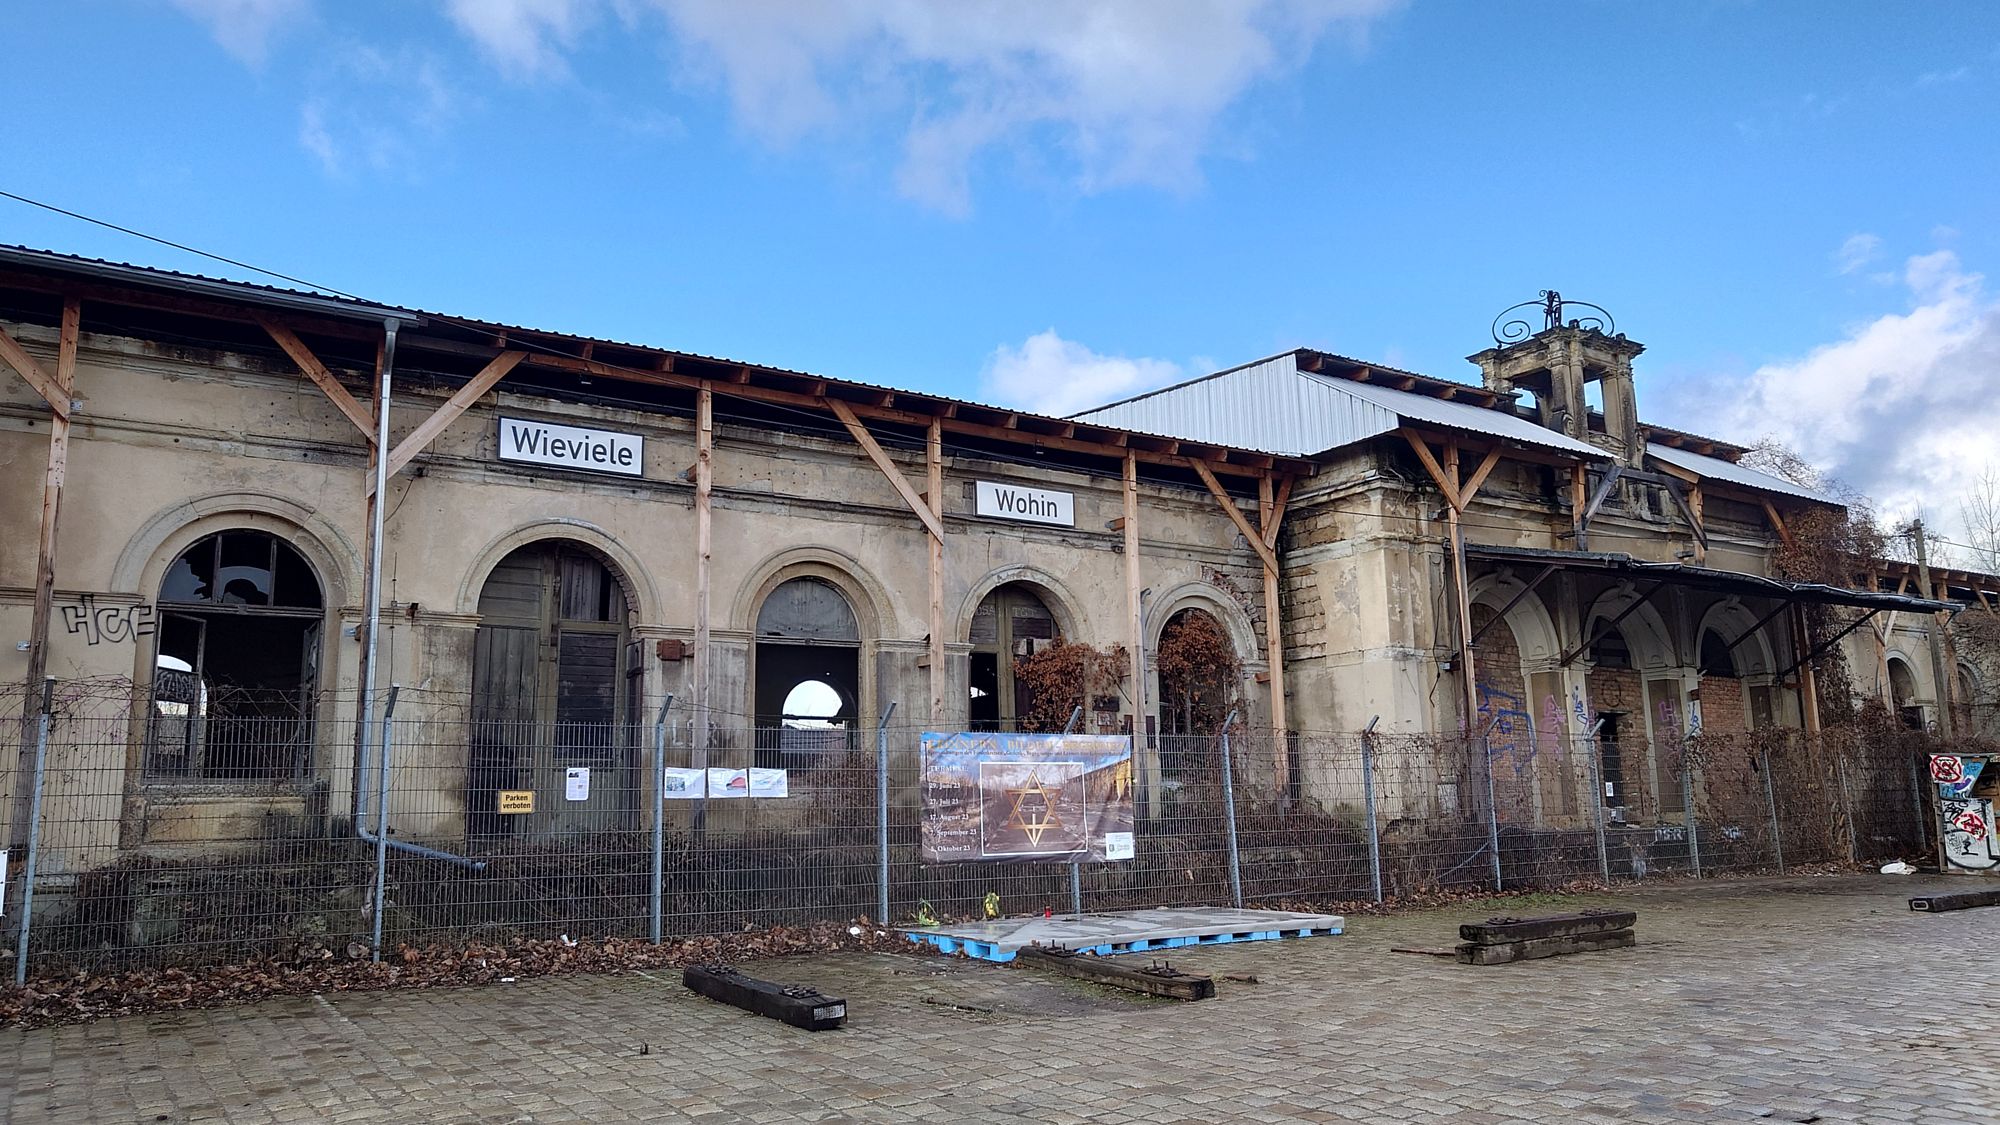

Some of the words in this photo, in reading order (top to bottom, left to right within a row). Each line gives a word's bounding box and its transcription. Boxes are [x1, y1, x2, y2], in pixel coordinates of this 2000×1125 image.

[511, 425, 633, 467] Wieviele
[995, 488, 1058, 518] Wohin
[936, 829, 969, 837] September
